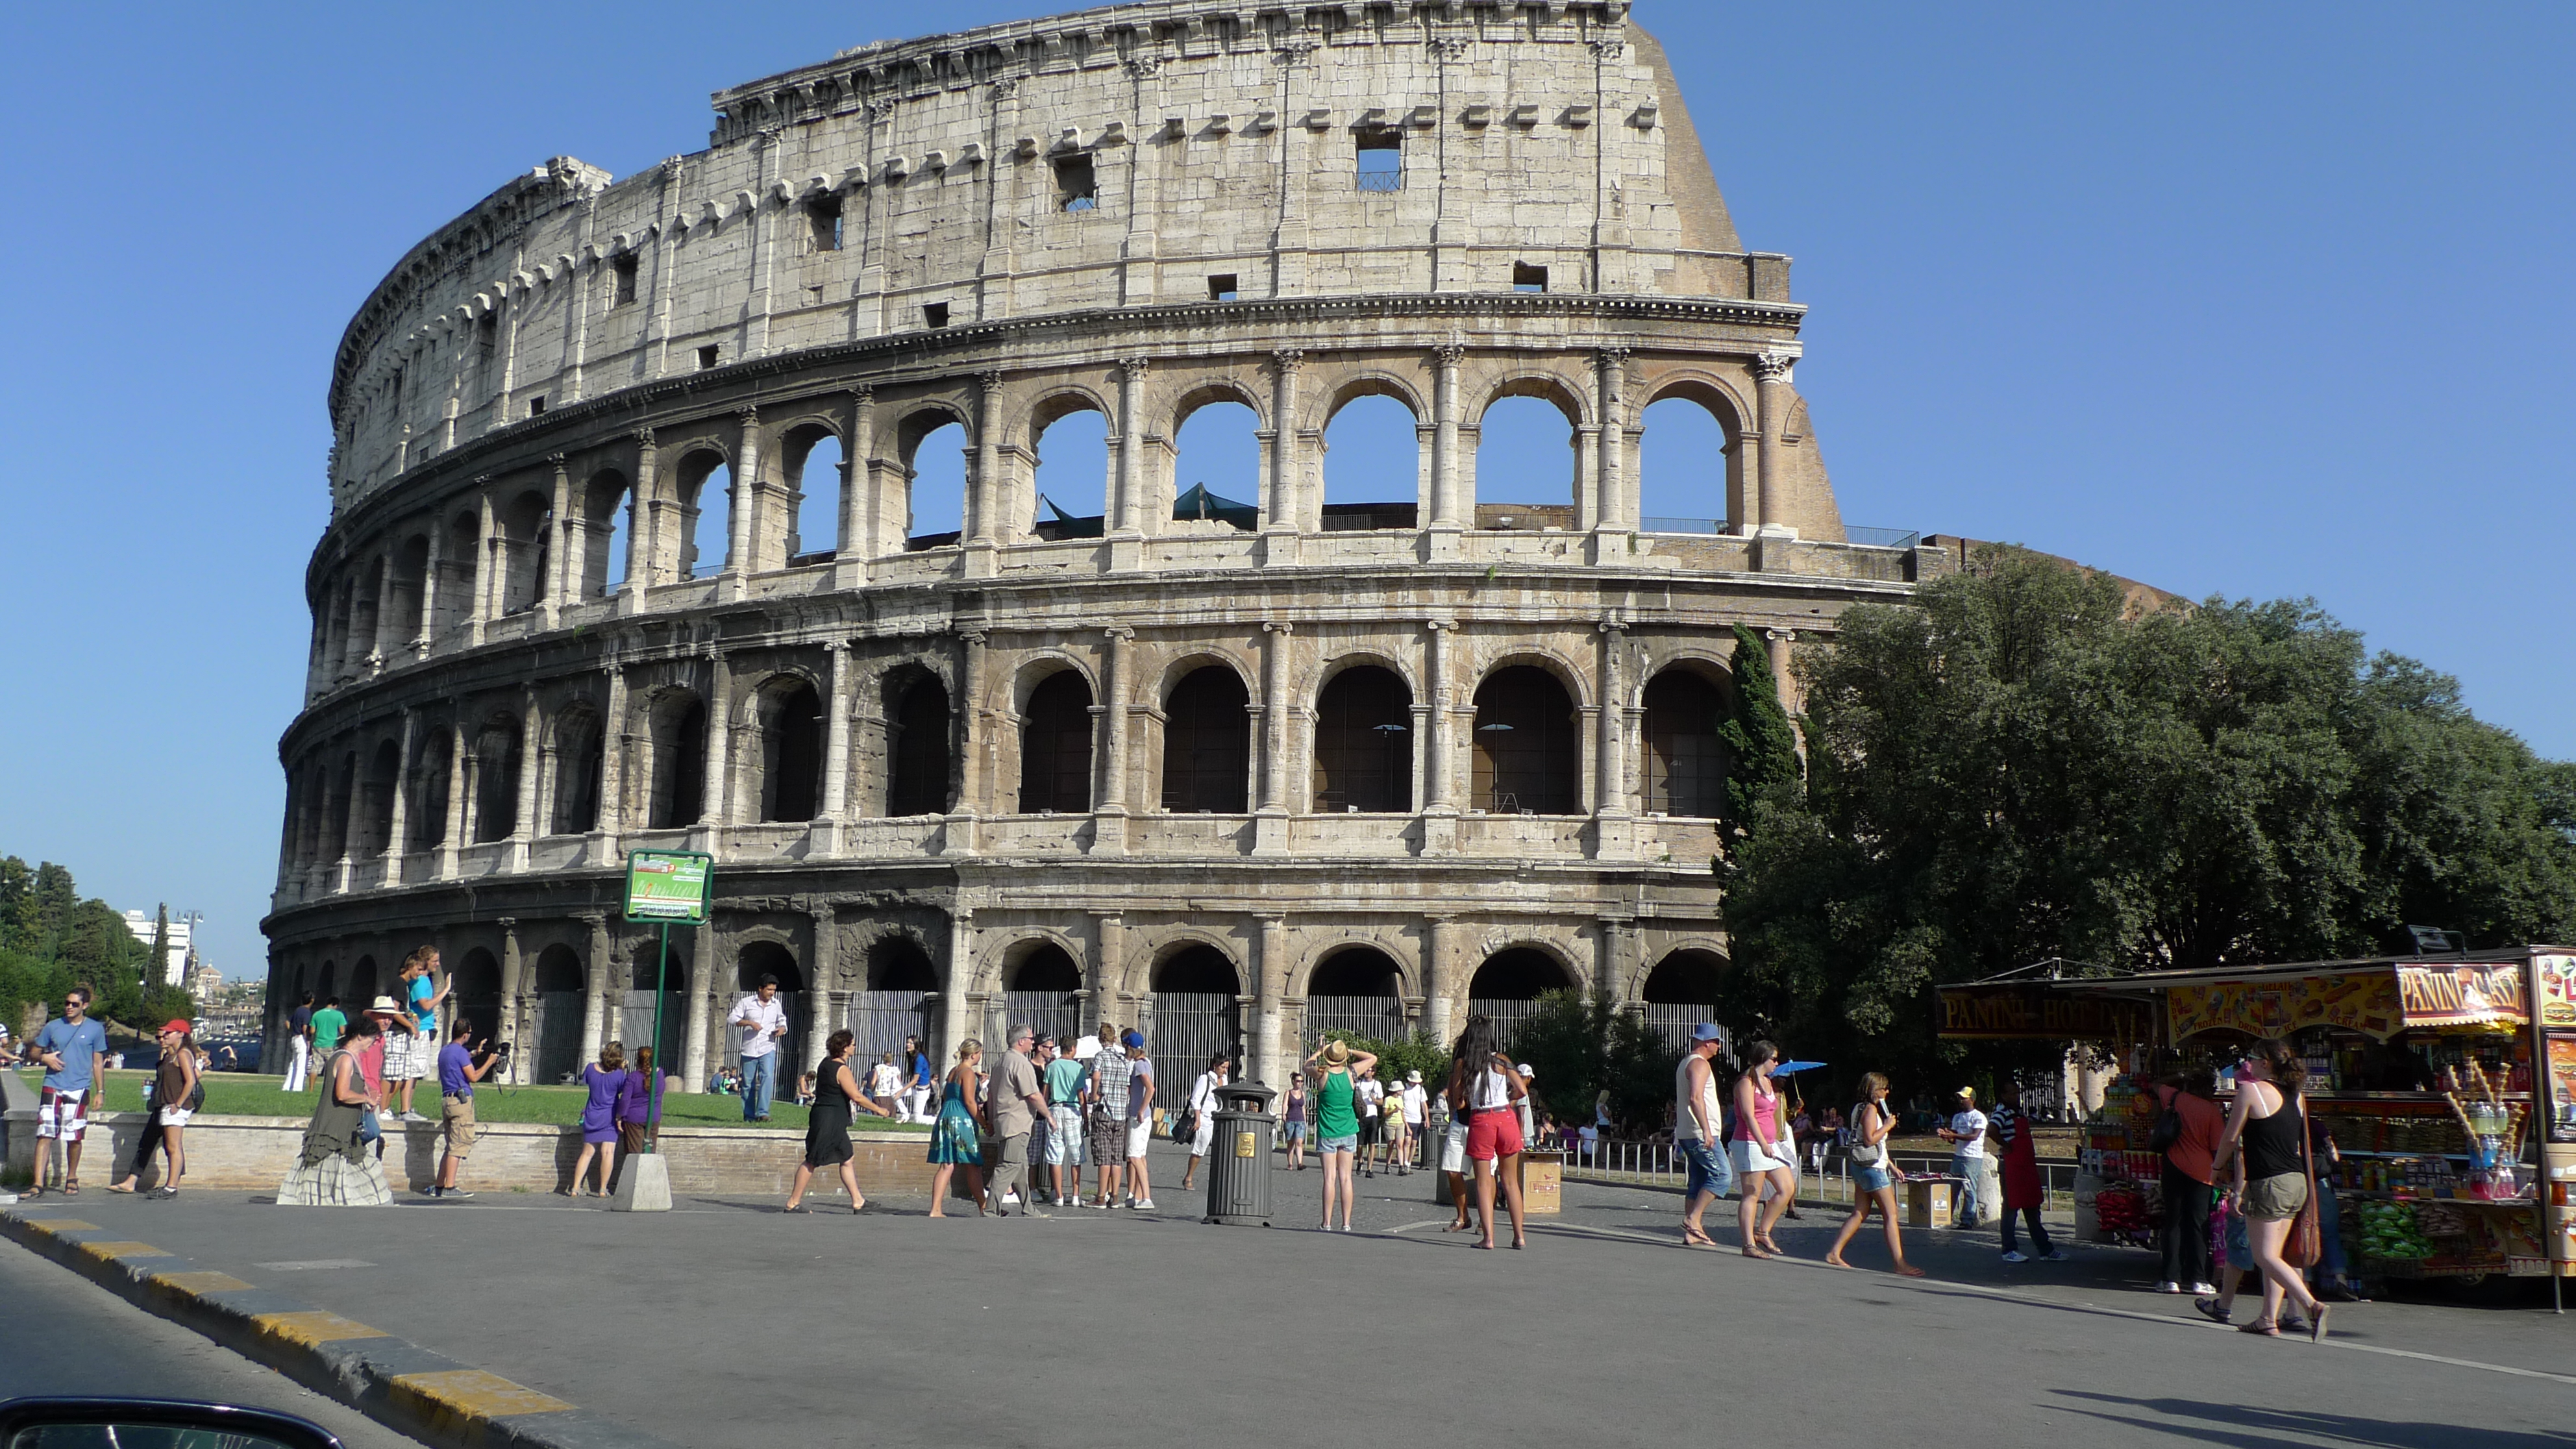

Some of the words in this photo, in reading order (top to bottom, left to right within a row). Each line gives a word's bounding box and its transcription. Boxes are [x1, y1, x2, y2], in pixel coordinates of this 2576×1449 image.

[2399, 972, 2469, 1011] PANINI
[1942, 998, 2026, 1030] PANINI
[2044, 999, 2090, 1030] HOT
[2194, 1017, 2223, 1030] FROZEN
[2238, 1021, 2263, 1036] DRINK
[2285, 1022, 2297, 1032] ICE
[2336, 1017, 2367, 1030] CREAM
